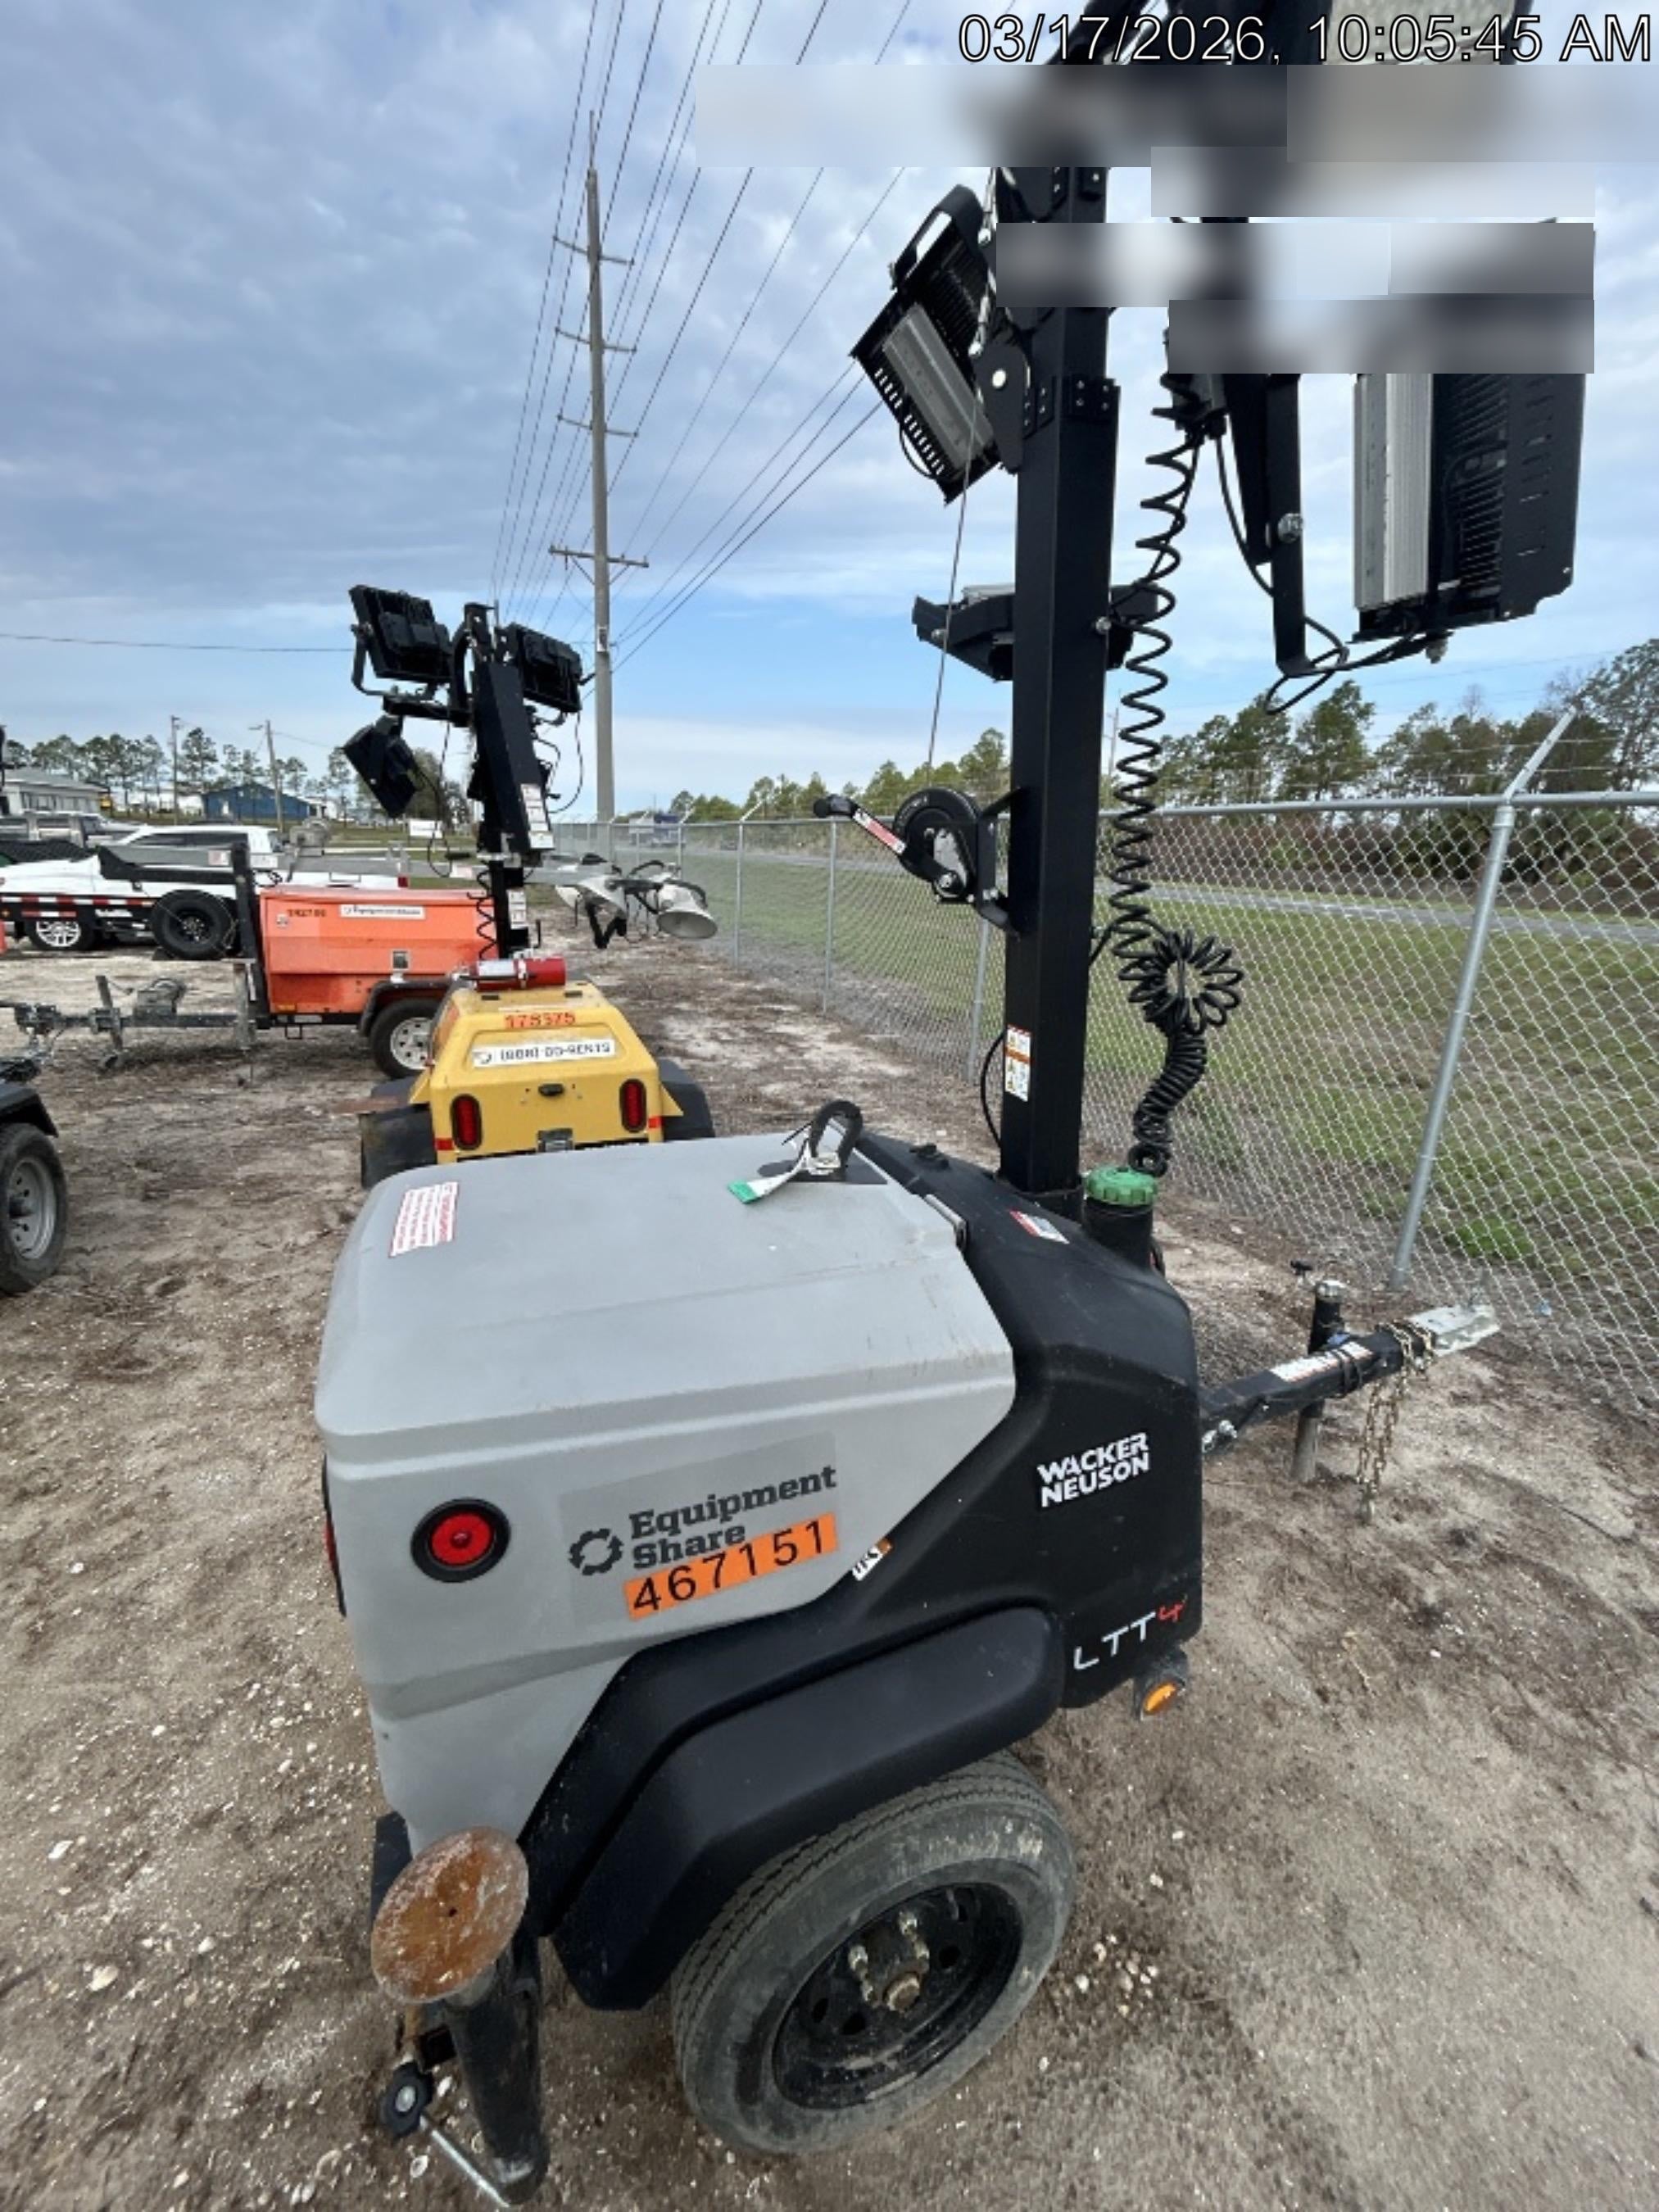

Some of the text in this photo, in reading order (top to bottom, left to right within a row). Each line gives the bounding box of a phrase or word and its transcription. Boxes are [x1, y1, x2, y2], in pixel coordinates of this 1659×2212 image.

[1036, 1432, 1149, 1484] WACKER
[1040, 1452, 1149, 1507] NEUSON
[629, 1465, 836, 1539] Equipment
[633, 1525, 746, 1569] Share
[633, 1520, 823, 1611] 467151
